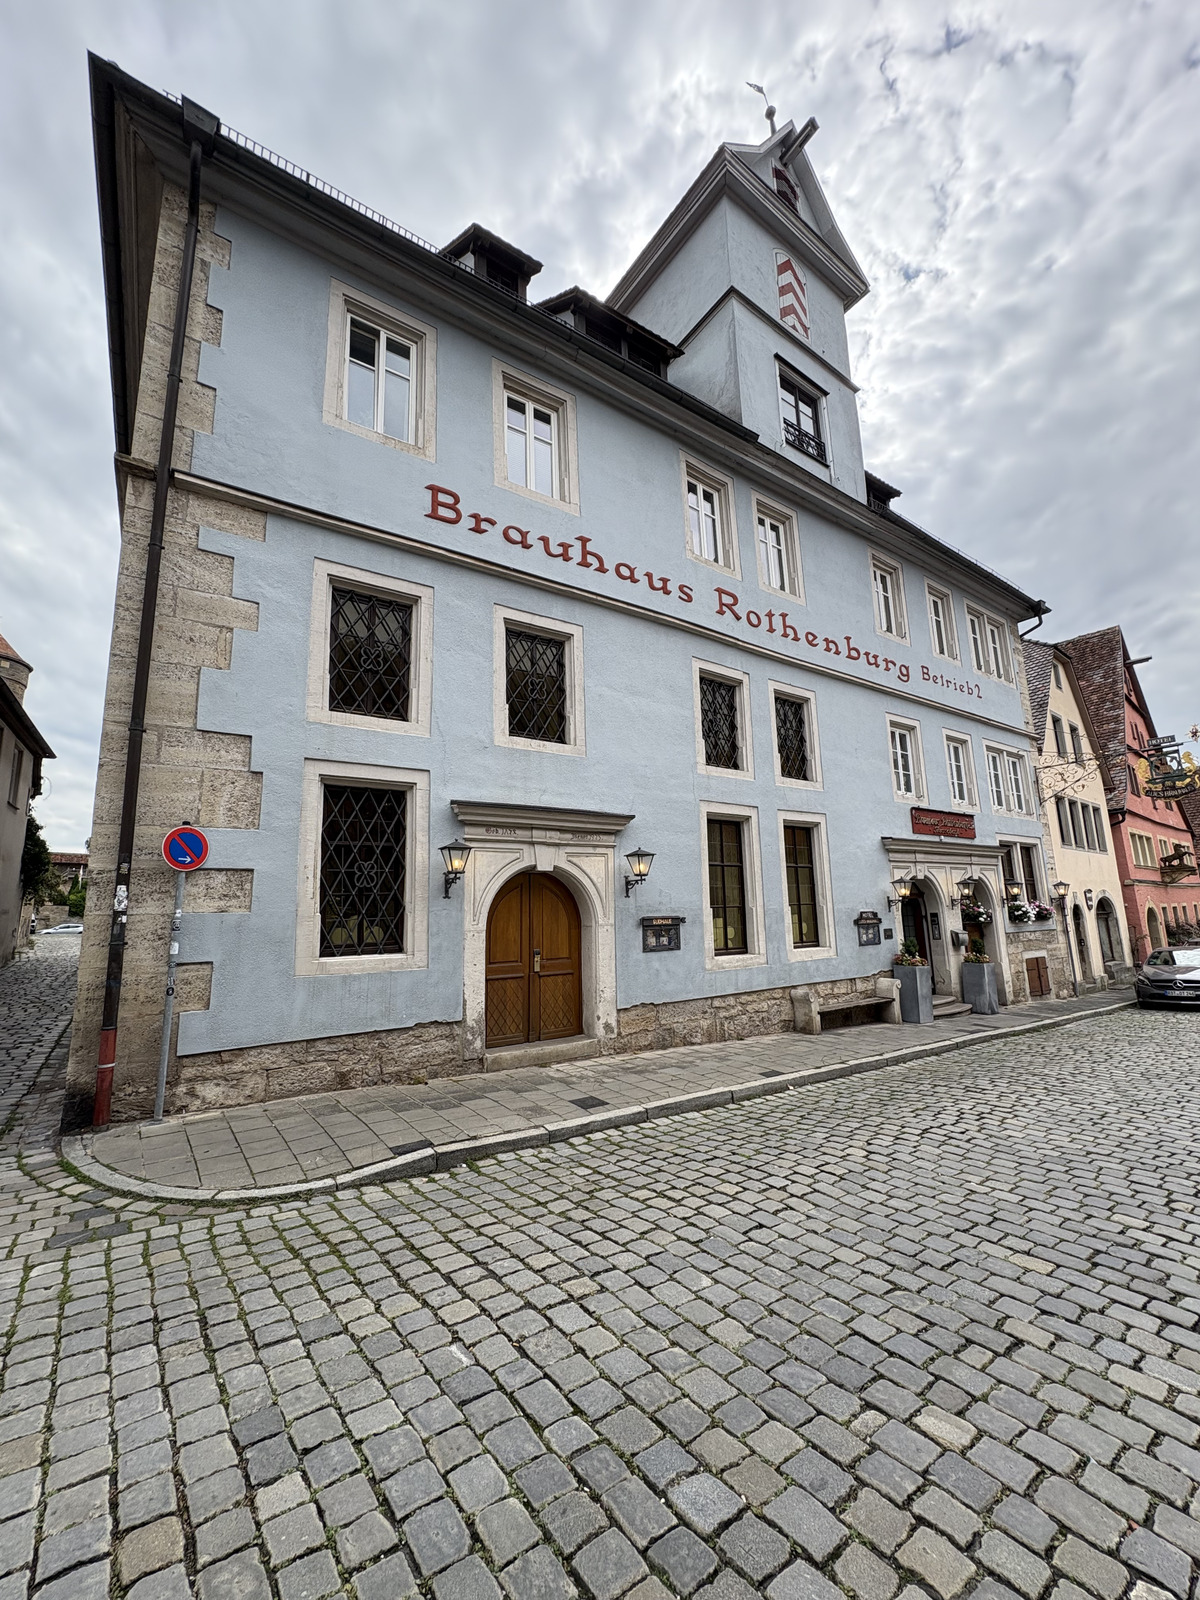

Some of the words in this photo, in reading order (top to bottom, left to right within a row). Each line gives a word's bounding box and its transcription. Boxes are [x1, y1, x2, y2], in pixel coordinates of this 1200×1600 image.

[424, 483, 694, 603] Brauhaus
[713, 586, 911, 683] Rothenburg
[1149, 737, 1172, 745] HOTEL
